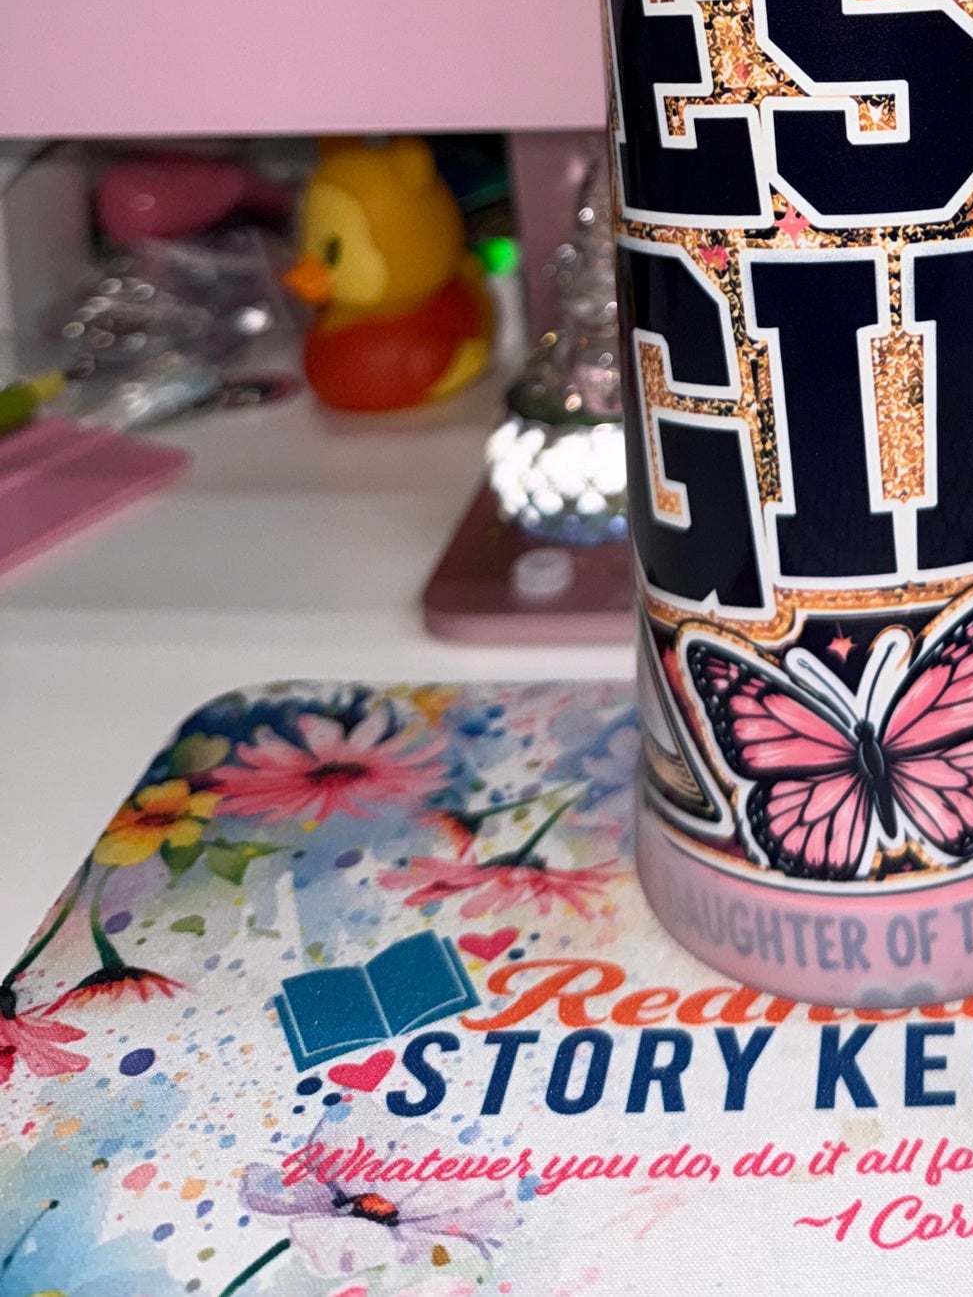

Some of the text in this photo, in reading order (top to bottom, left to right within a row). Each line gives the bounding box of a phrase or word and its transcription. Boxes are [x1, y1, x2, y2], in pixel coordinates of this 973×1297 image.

[886, 907, 938, 968] OF
[385, 1026, 776, 1118] STORY
[282, 1136, 533, 1187] Whatever
[535, 1151, 640, 1196] you
[648, 1143, 721, 1184] do,
[733, 1142, 795, 1179] do
[808, 1140, 850, 1176] it
[856, 1139, 916, 1174] all
